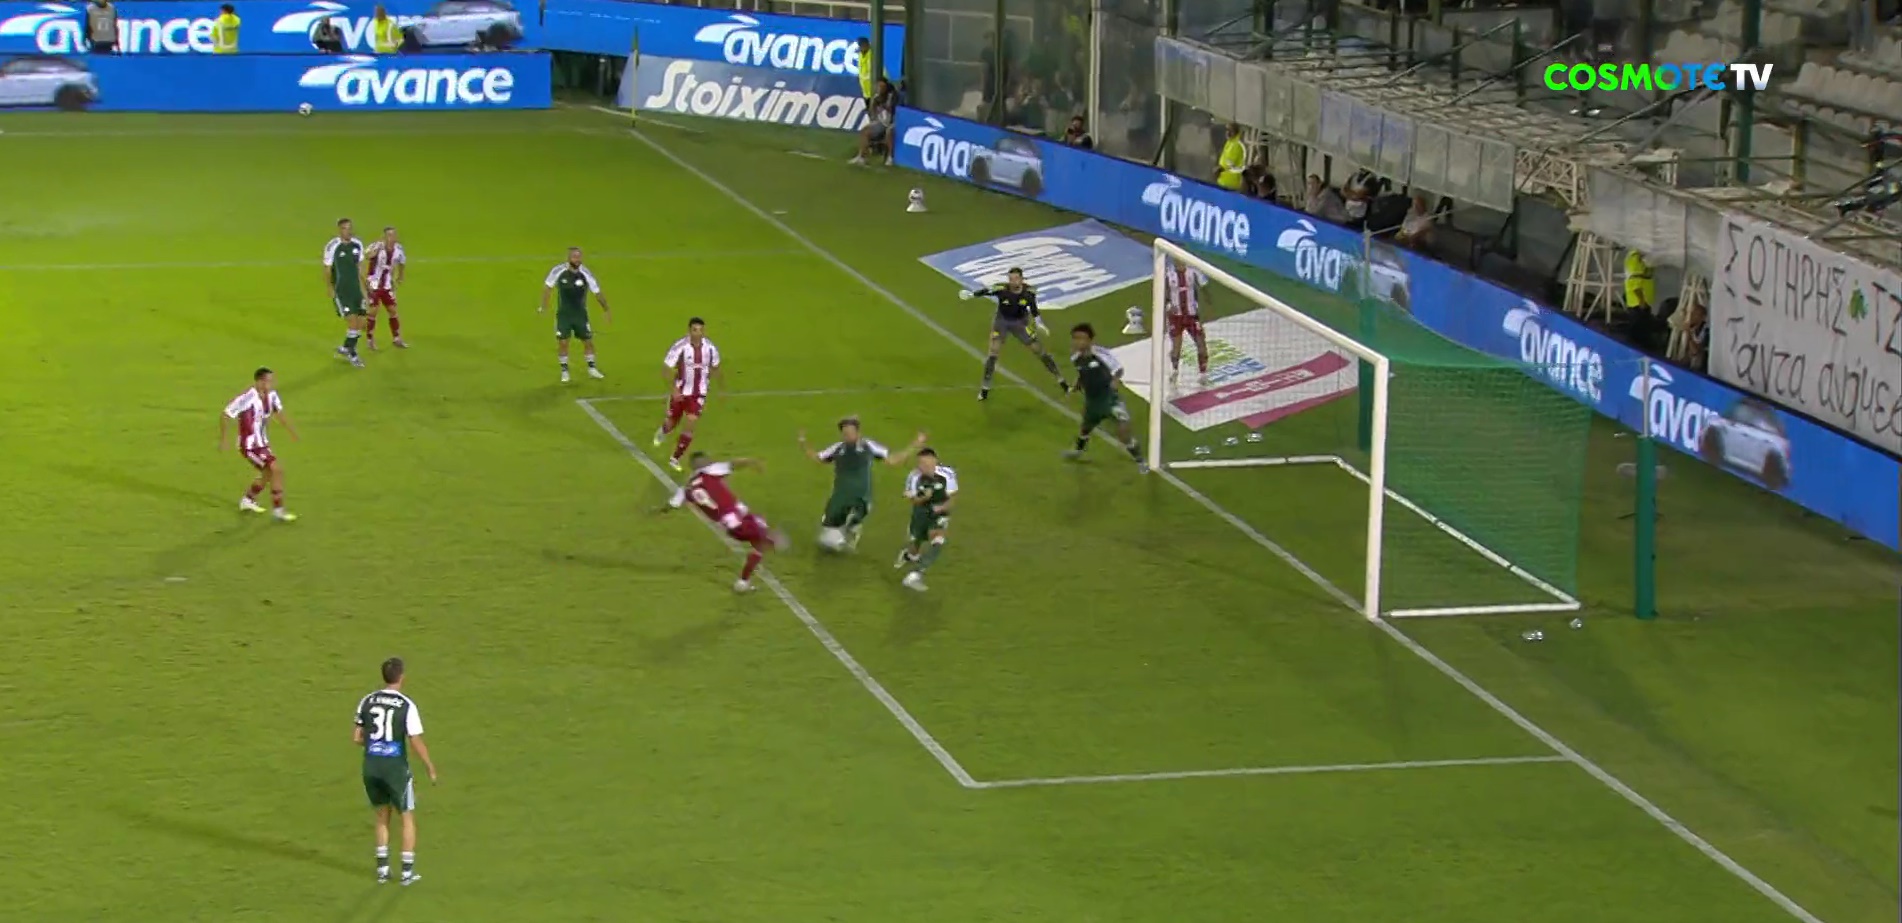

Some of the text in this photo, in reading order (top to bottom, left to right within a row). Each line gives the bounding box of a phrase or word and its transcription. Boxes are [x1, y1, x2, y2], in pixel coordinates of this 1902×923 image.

[336, 67, 514, 105] avance
[646, 60, 868, 132] Stoiximan
[1160, 191, 1251, 257] avance
[1520, 317, 1604, 403] avance
[368, 705, 395, 742] 31
